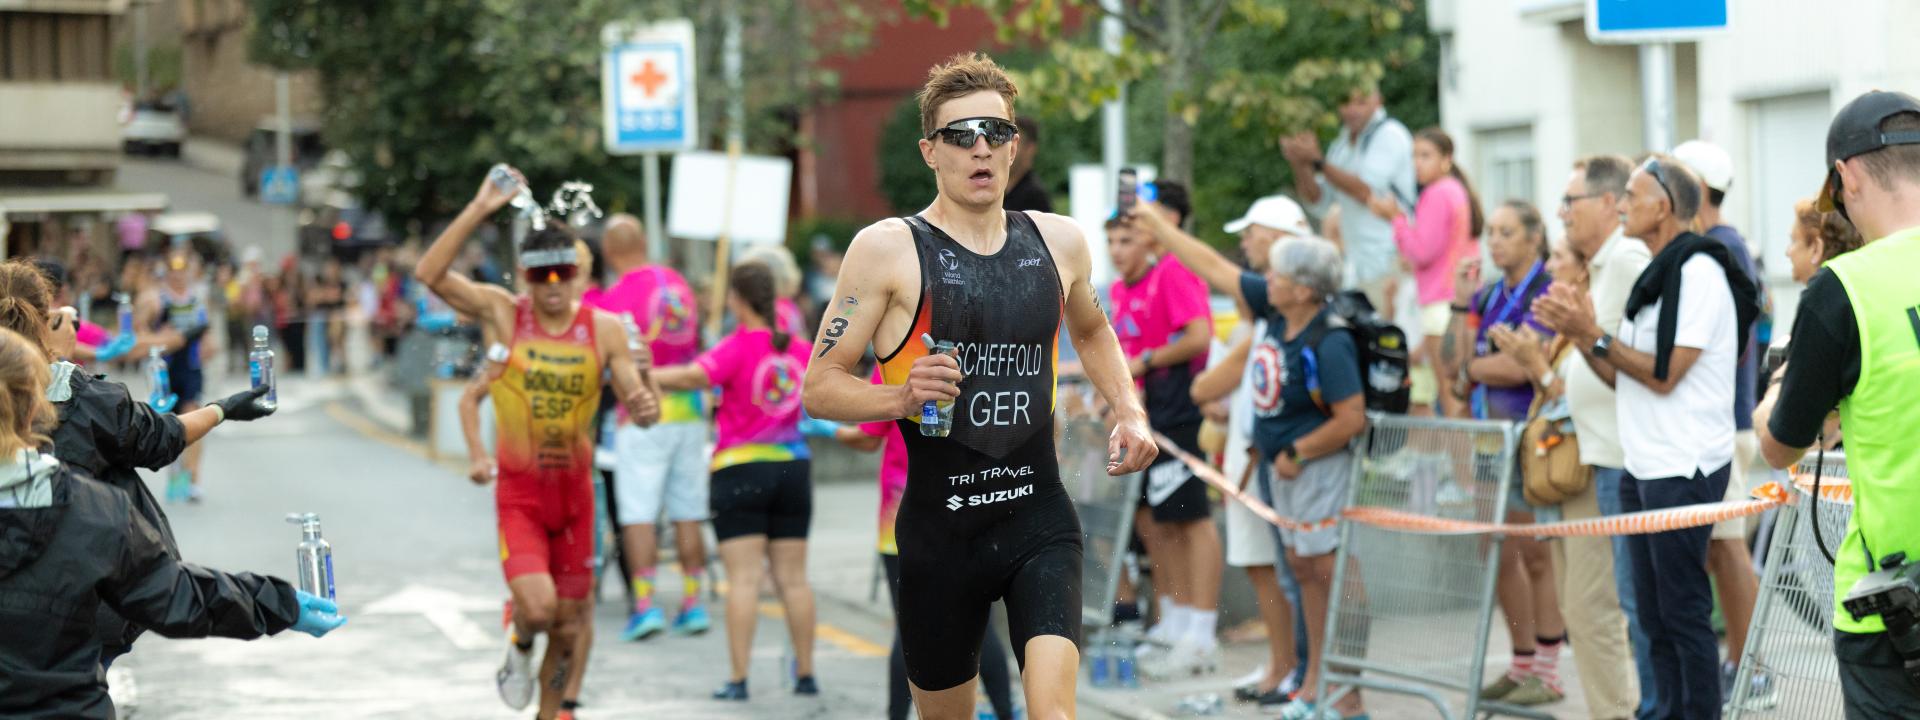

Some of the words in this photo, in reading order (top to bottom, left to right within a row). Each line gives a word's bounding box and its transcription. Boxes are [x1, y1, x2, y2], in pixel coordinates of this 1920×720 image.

[942, 277, 965, 285] Triathlon
[956, 342, 1042, 376] SCHEFFOLD
[532, 396, 573, 419] ESP
[969, 391, 1031, 427] GER
[948, 473, 975, 486] TRI
[980, 465, 1034, 481] TRAVEL
[968, 484, 1033, 507] SUZUKI
